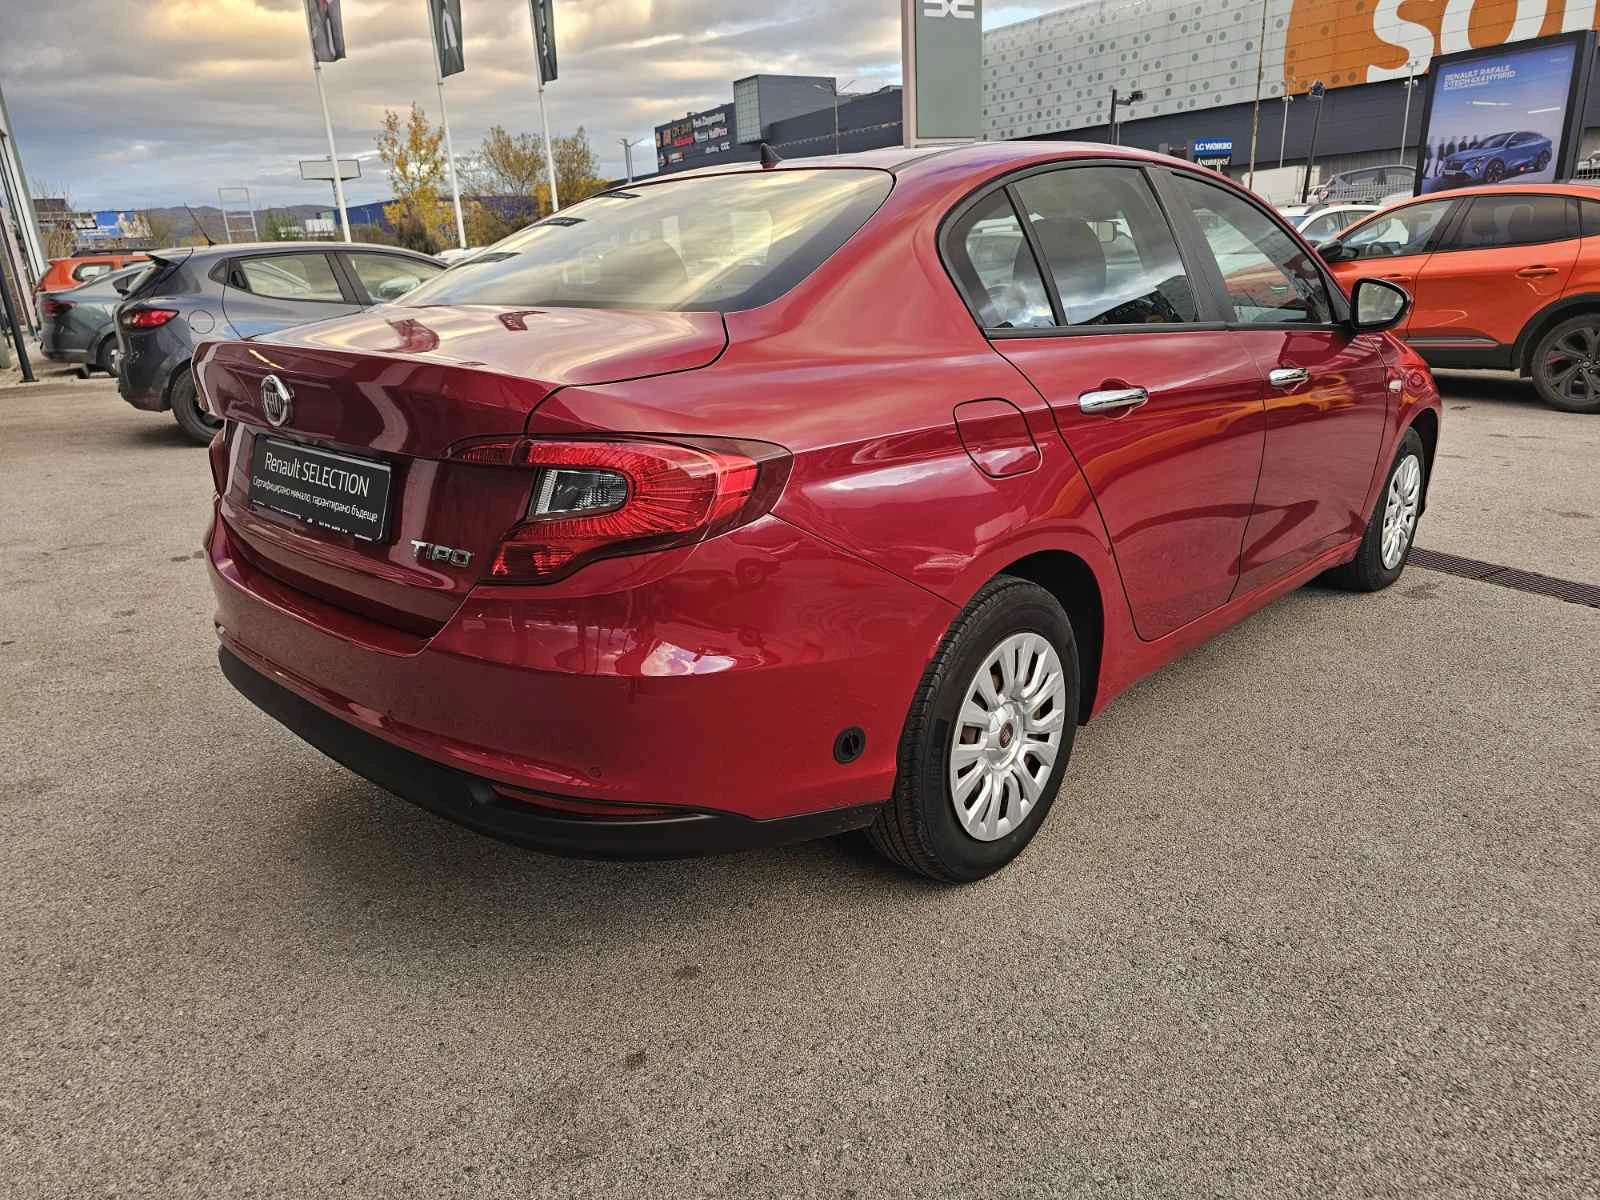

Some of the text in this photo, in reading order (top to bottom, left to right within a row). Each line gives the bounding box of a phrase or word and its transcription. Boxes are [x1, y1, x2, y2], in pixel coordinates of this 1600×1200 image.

[1195, 143, 1204, 151] LC
[264, 452, 370, 497] Renault SELECTION
[312, 495, 350, 513] гарантирано
[351, 504, 378, 523] бъдеще
[410, 539, 474, 568] TIPO
